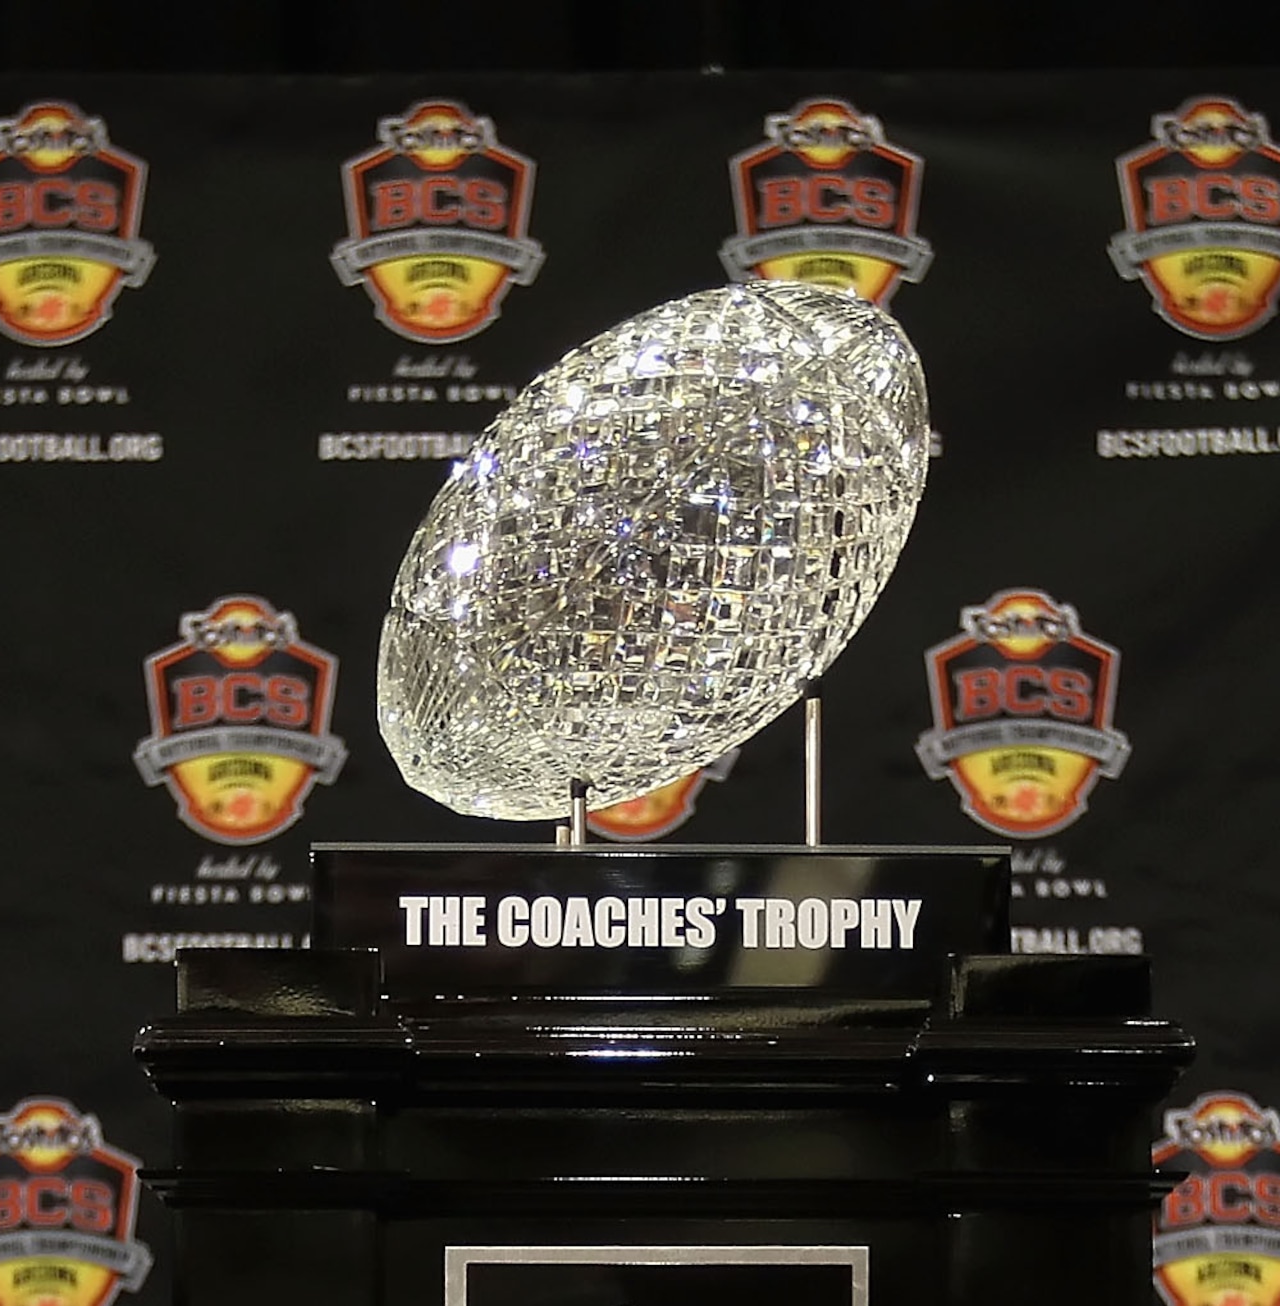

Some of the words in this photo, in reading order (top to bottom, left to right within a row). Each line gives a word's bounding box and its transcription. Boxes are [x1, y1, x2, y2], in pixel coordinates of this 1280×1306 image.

[373, 172, 508, 229] BCS
[761, 169, 897, 226] BCS
[176, 670, 310, 727] BCS
[957, 662, 1092, 719] BCS
[249, 884, 311, 904] BOW
[399, 896, 486, 947] THE
[497, 895, 725, 948] COACHES'
[736, 898, 922, 950] TROPHY
